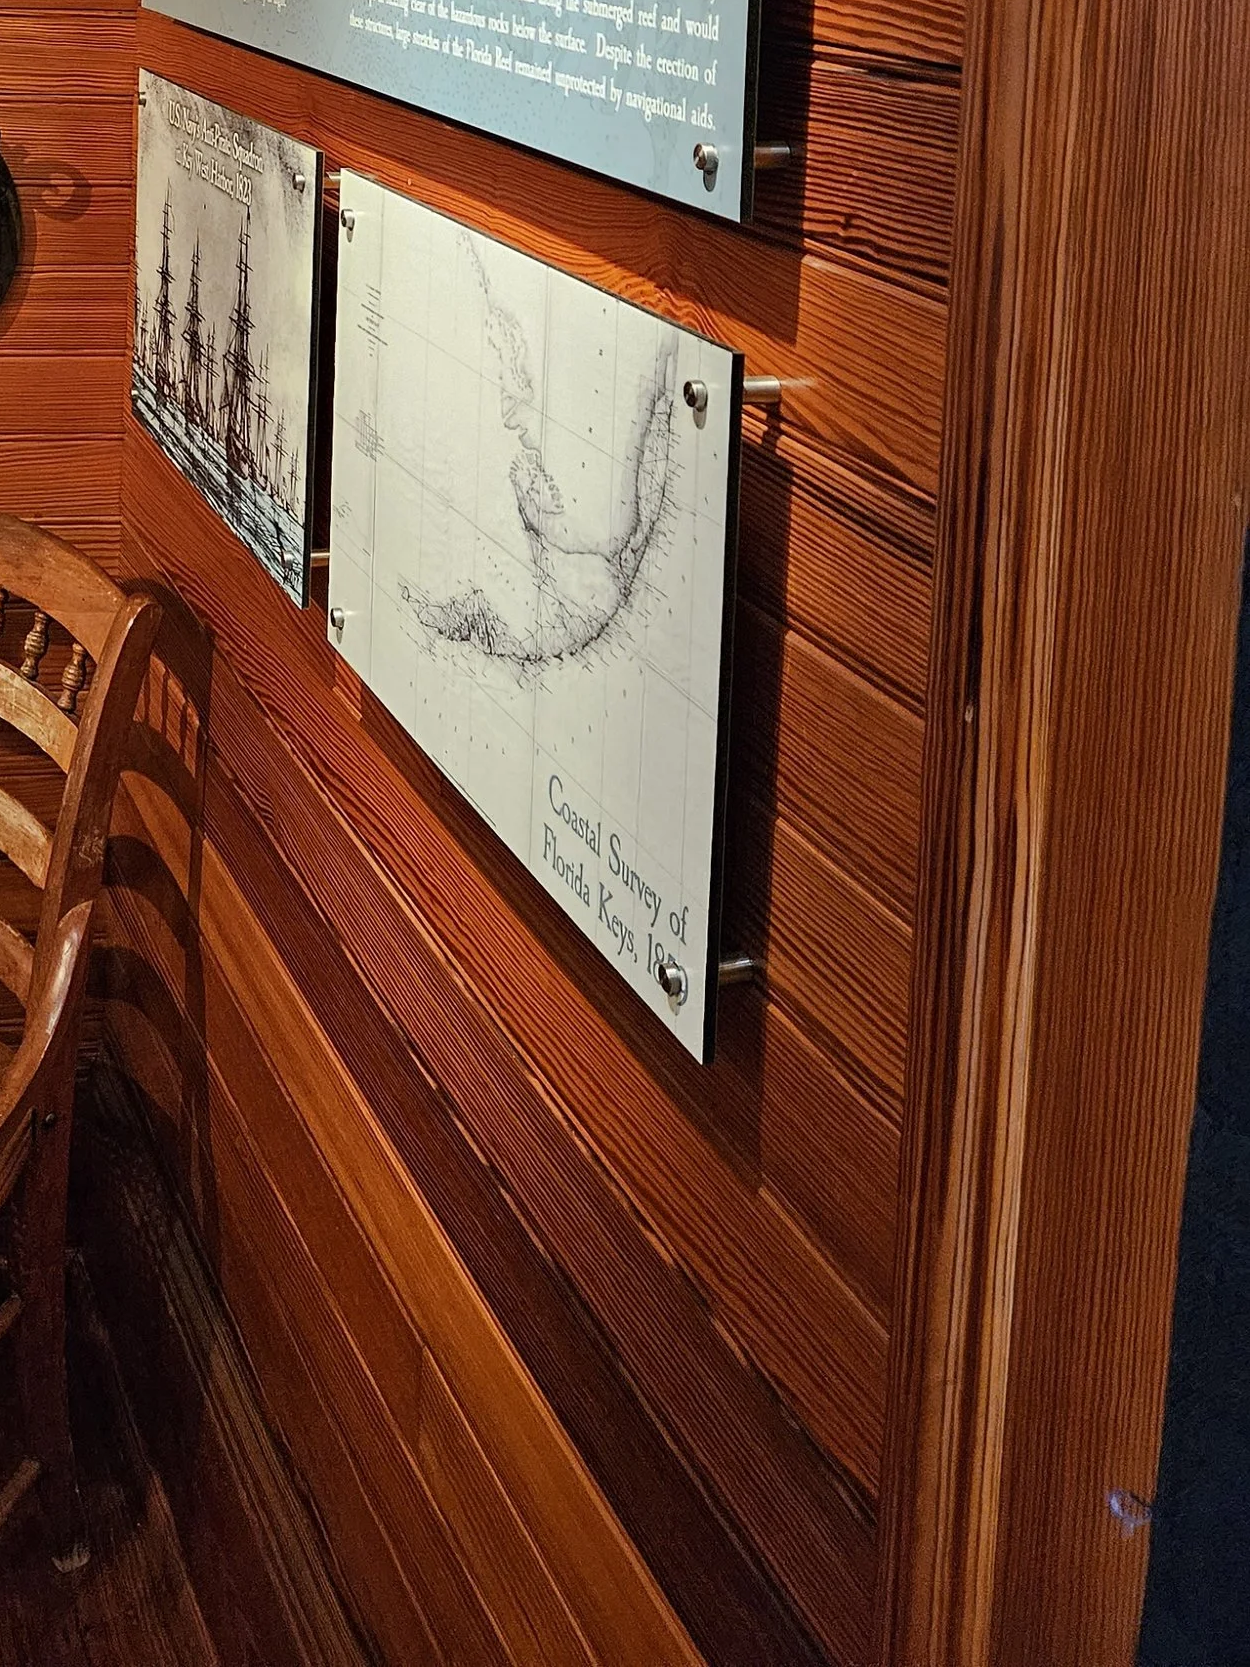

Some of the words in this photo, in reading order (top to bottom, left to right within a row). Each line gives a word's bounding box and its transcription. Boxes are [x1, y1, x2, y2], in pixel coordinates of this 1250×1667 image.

[511, 14, 536, 40] below
[538, 20, 552, 45] the
[554, 27, 587, 53] surface.
[595, 32, 632, 70] Despite
[635, 43, 652, 70] the
[656, 57, 699, 81] erection
[703, 59, 717, 86] of
[637, 3, 658, 28] reef
[660, 7, 681, 33] and
[685, 14, 719, 41] would
[494, 45, 513, 72] Reef
[609, 77, 623, 112] by
[625, 91, 686, 122] navigational
[690, 102, 716, 130] aids.
[231, 131, 264, 174] Squadron
[235, 172, 252, 207] 1823
[548, 775, 601, 857] Coastal
[608, 833, 661, 927] Survey
[668, 906, 689, 945] of
[543, 823, 590, 907] Florida
[598, 882, 638, 963] Keys,
[647, 933, 689, 1006] 189
